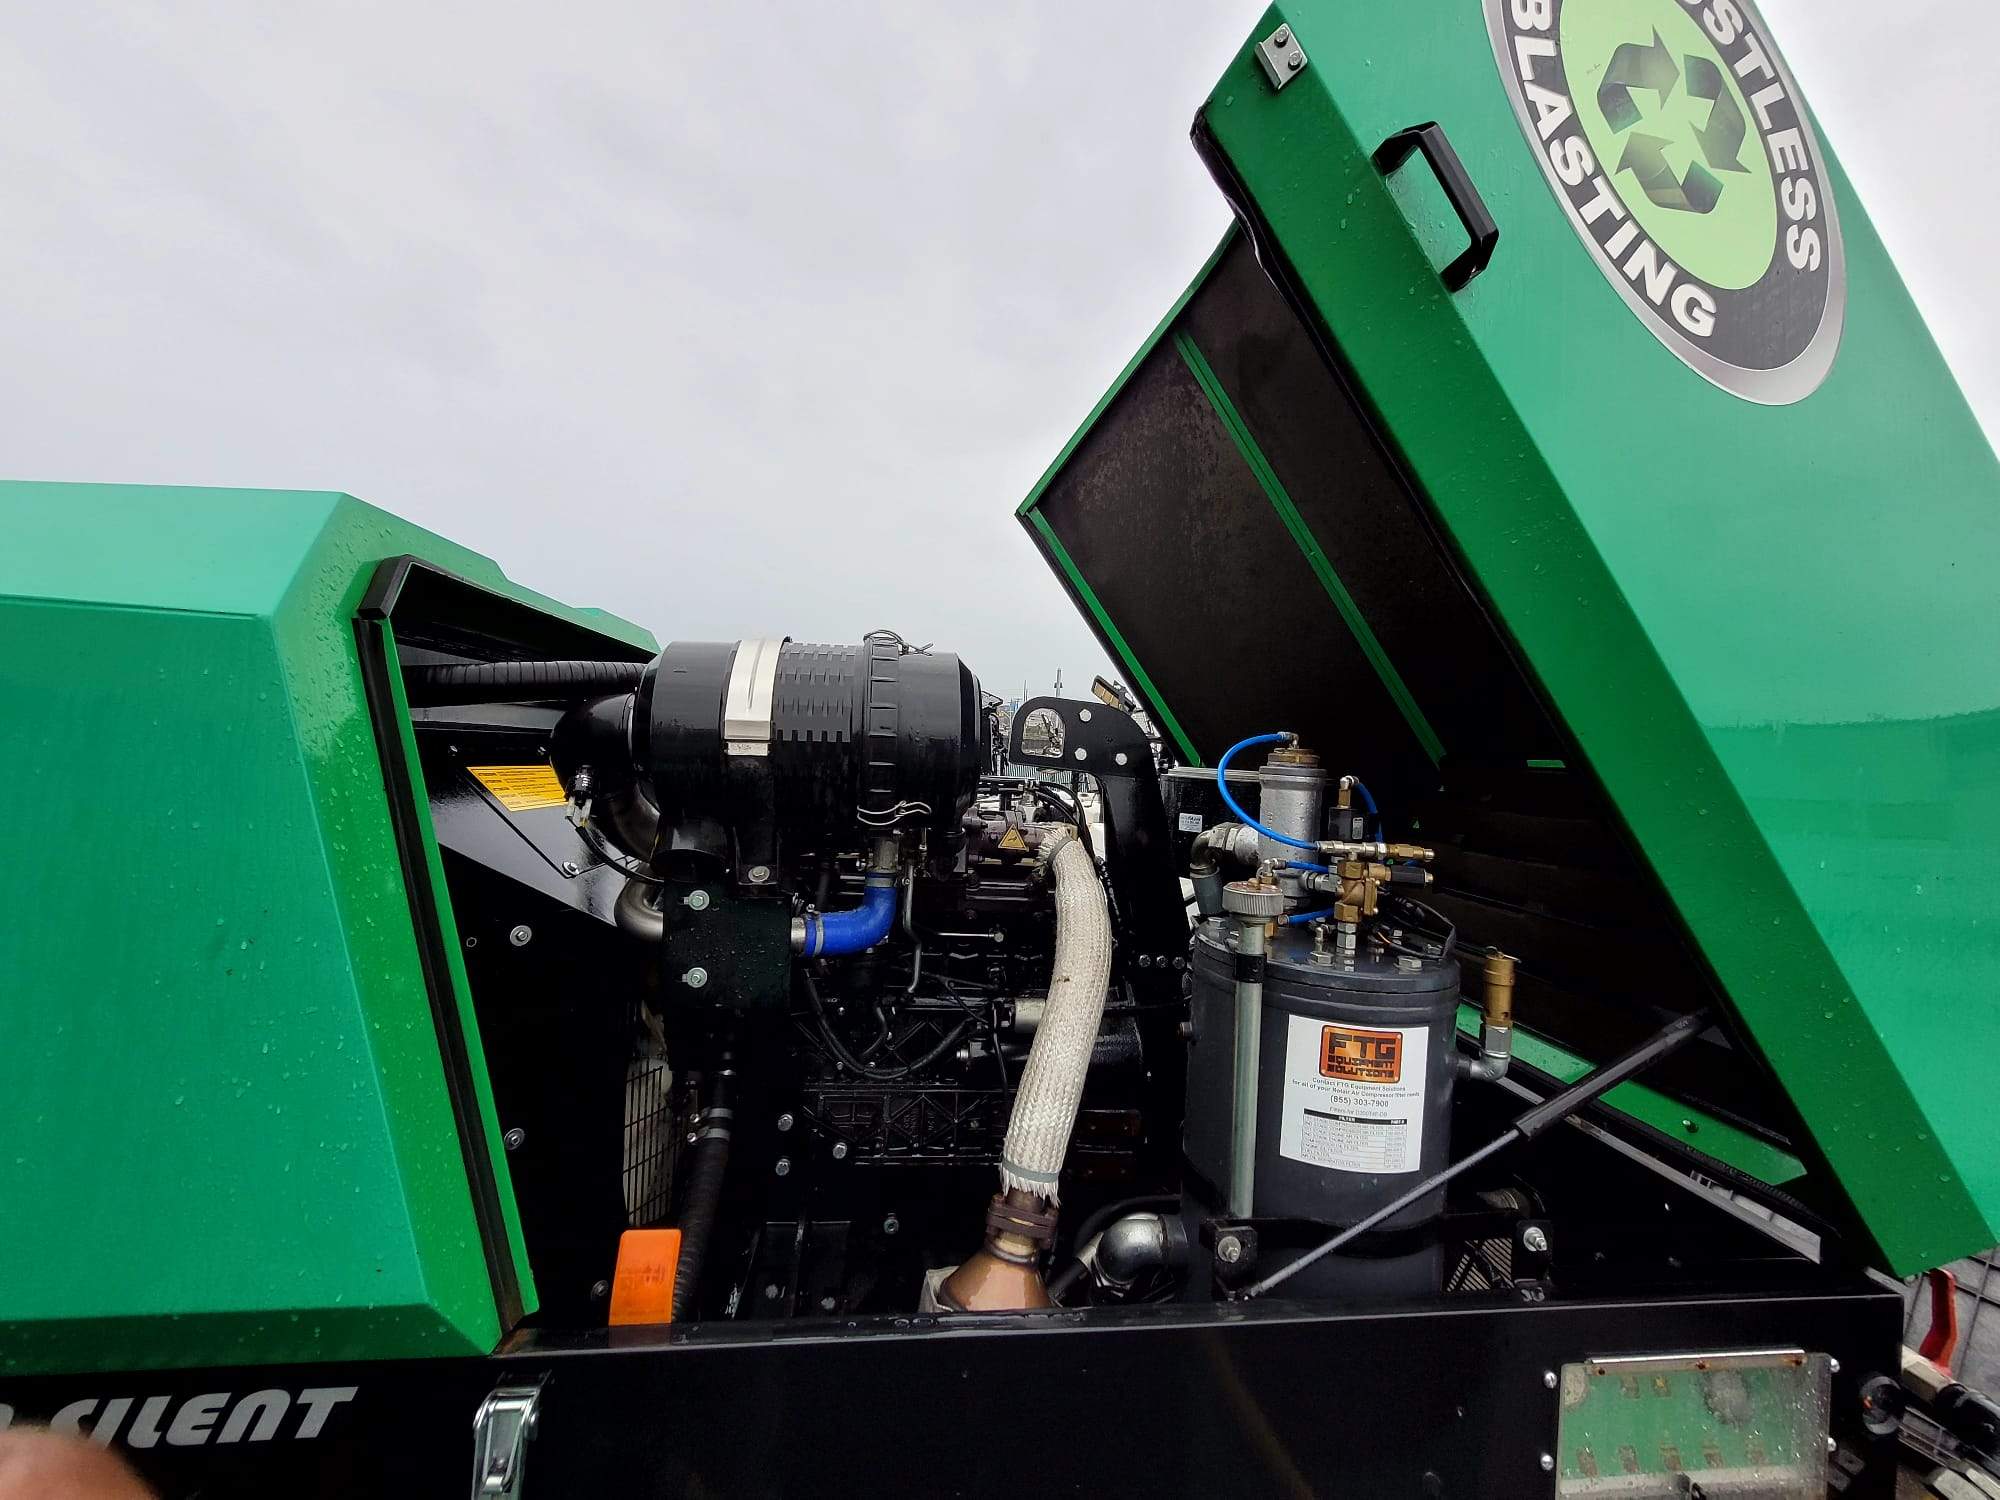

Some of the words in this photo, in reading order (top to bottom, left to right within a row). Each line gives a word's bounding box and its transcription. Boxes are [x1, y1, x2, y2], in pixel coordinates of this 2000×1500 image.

[1683, 0, 1821, 273] STLESS
[1511, 0, 1717, 338] BLASTING
[1329, 1031, 1396, 1060] FTG
[1328, 1054, 1395, 1069] EQUIPMENT
[1327, 1063, 1395, 1078] SOLUTIONS
[1312, 1077, 1336, 1086] Contact
[1350, 1083, 1381, 1091] Equipment
[1330, 1095, 1352, 1105] (855)
[1353, 1098, 1389, 1107] 303-7900
